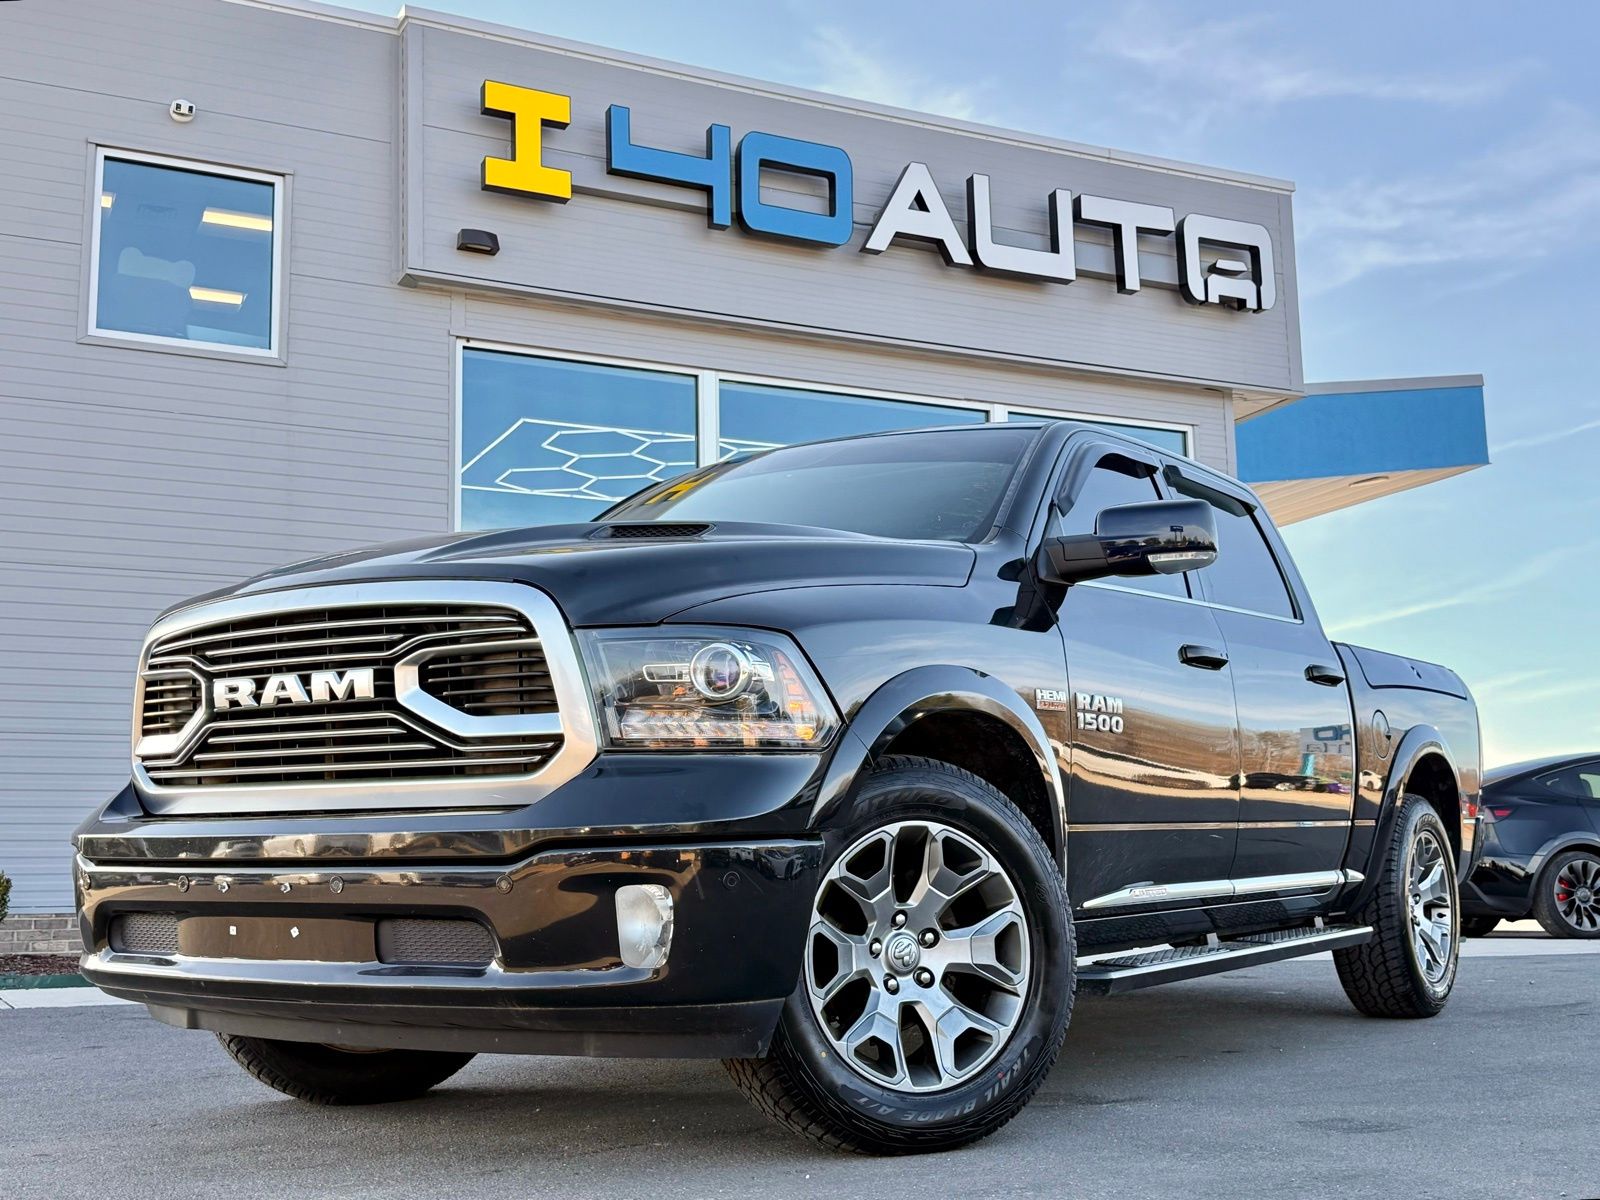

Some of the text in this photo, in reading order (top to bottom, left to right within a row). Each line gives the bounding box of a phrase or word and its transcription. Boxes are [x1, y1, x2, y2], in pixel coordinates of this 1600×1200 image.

[212, 668, 376, 709] RAM
[1075, 692, 1124, 715] RAM
[1076, 712, 1125, 735] 1500
[854, 1096, 898, 1115] A/T
[902, 1098, 977, 1122] BLADE
